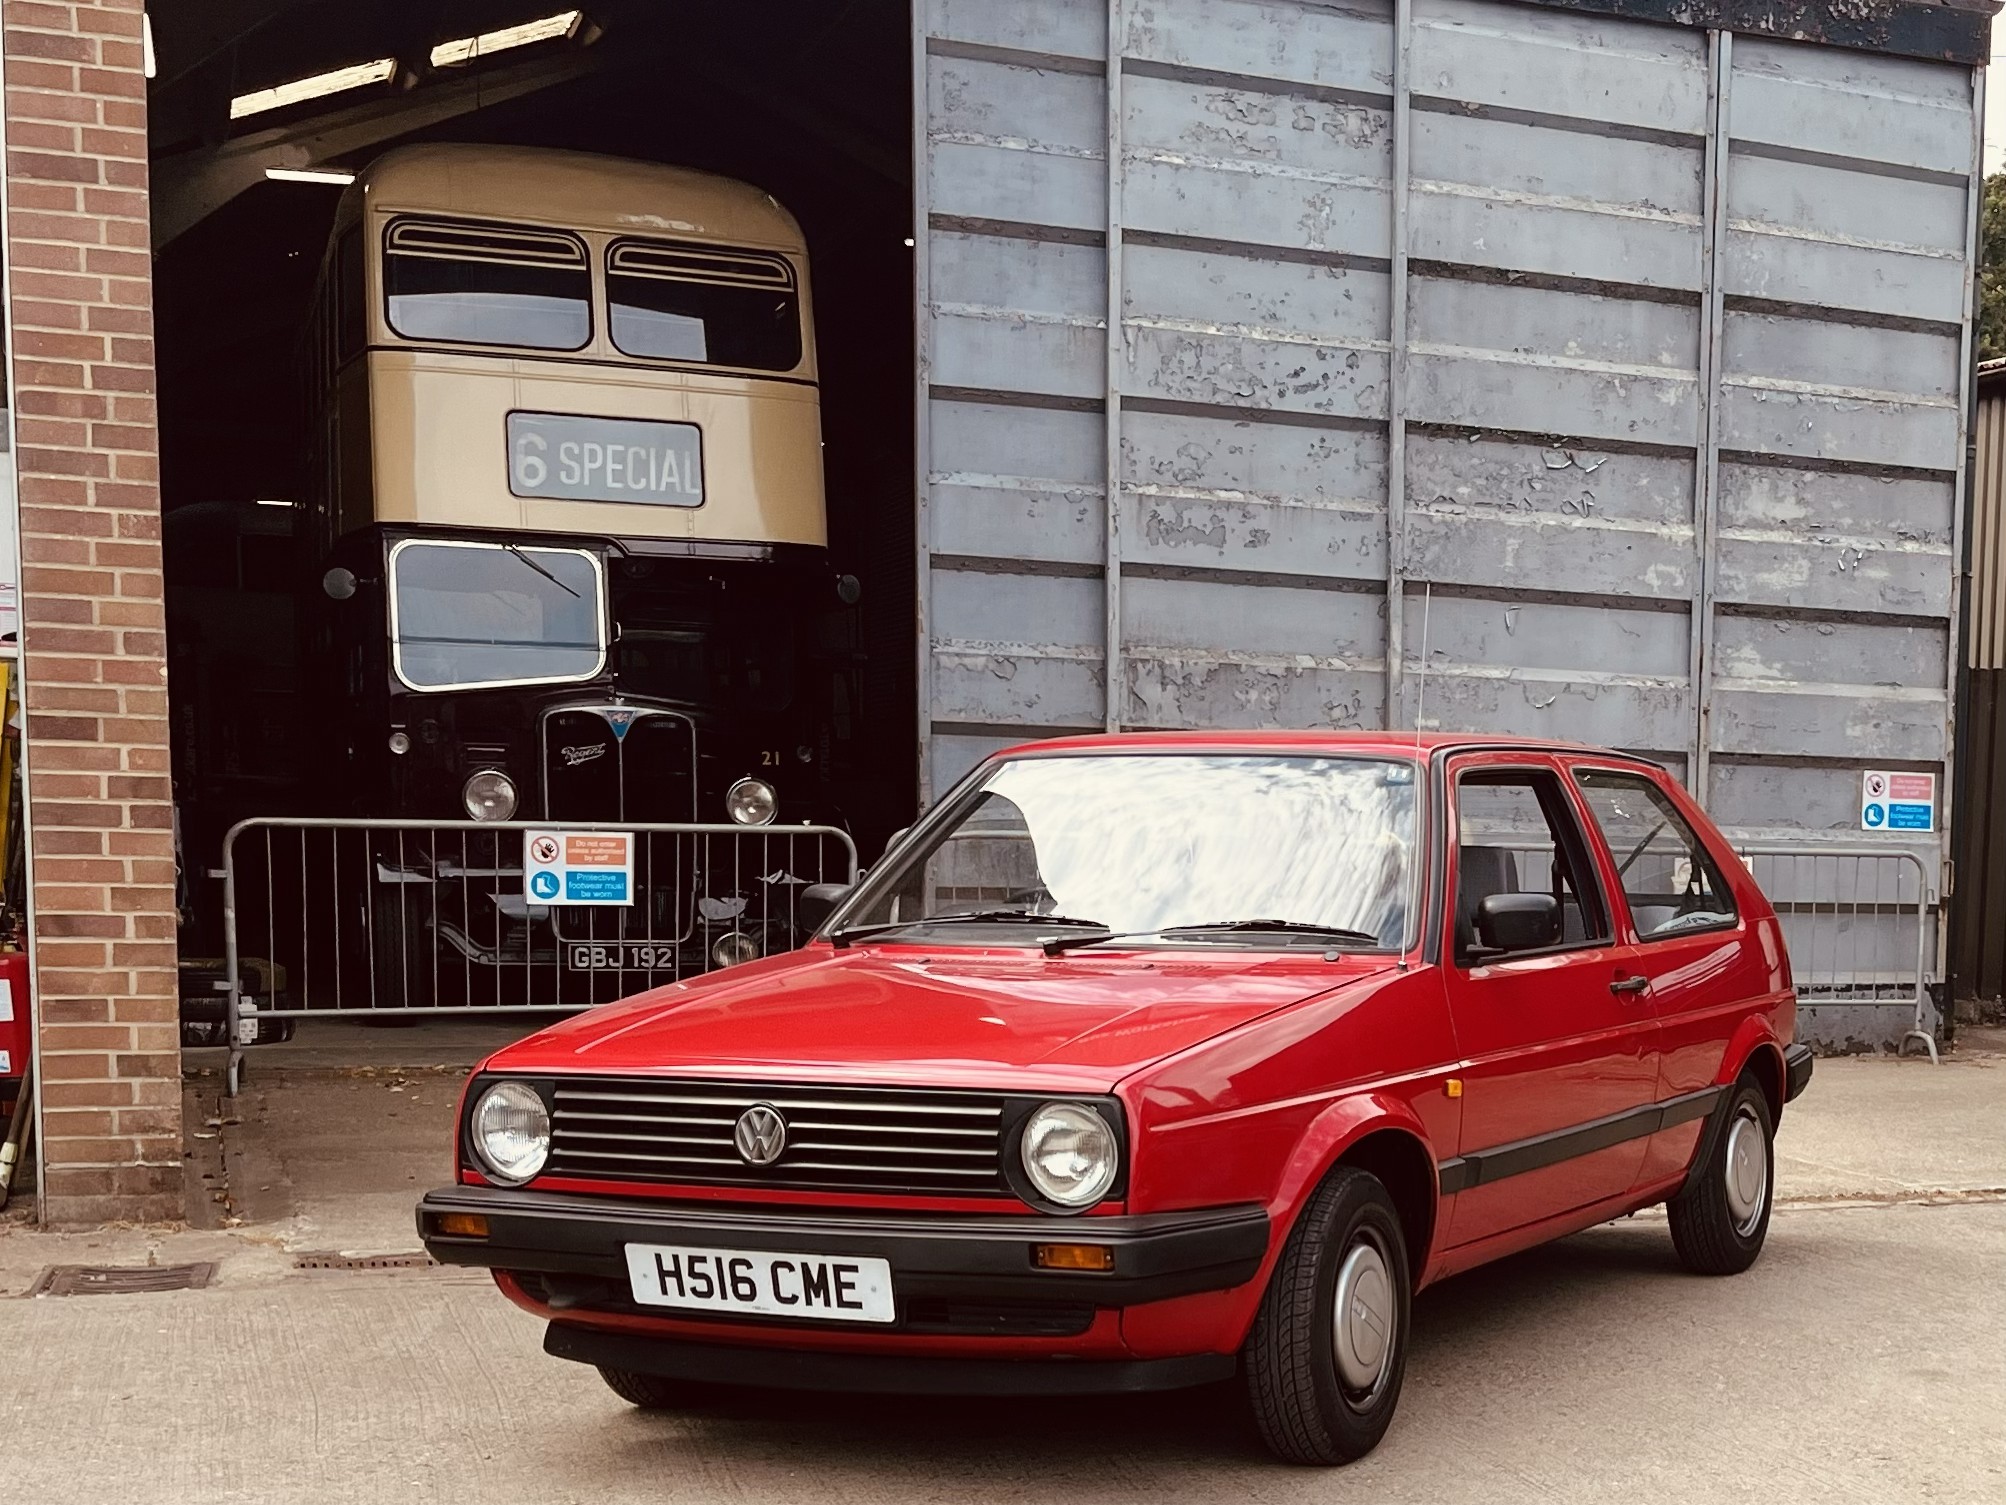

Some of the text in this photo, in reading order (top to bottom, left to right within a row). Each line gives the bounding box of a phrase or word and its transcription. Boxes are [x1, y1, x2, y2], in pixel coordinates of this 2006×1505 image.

[515, 432, 700, 495] 6 SPECIAL
[761, 751, 780, 766] 21
[576, 873, 617, 881] Protective
[568, 881, 603, 889] footwear
[580, 890, 591, 898] be
[574, 946, 672, 969] GBJ 192
[654, 1252, 864, 1310] H516 CME
